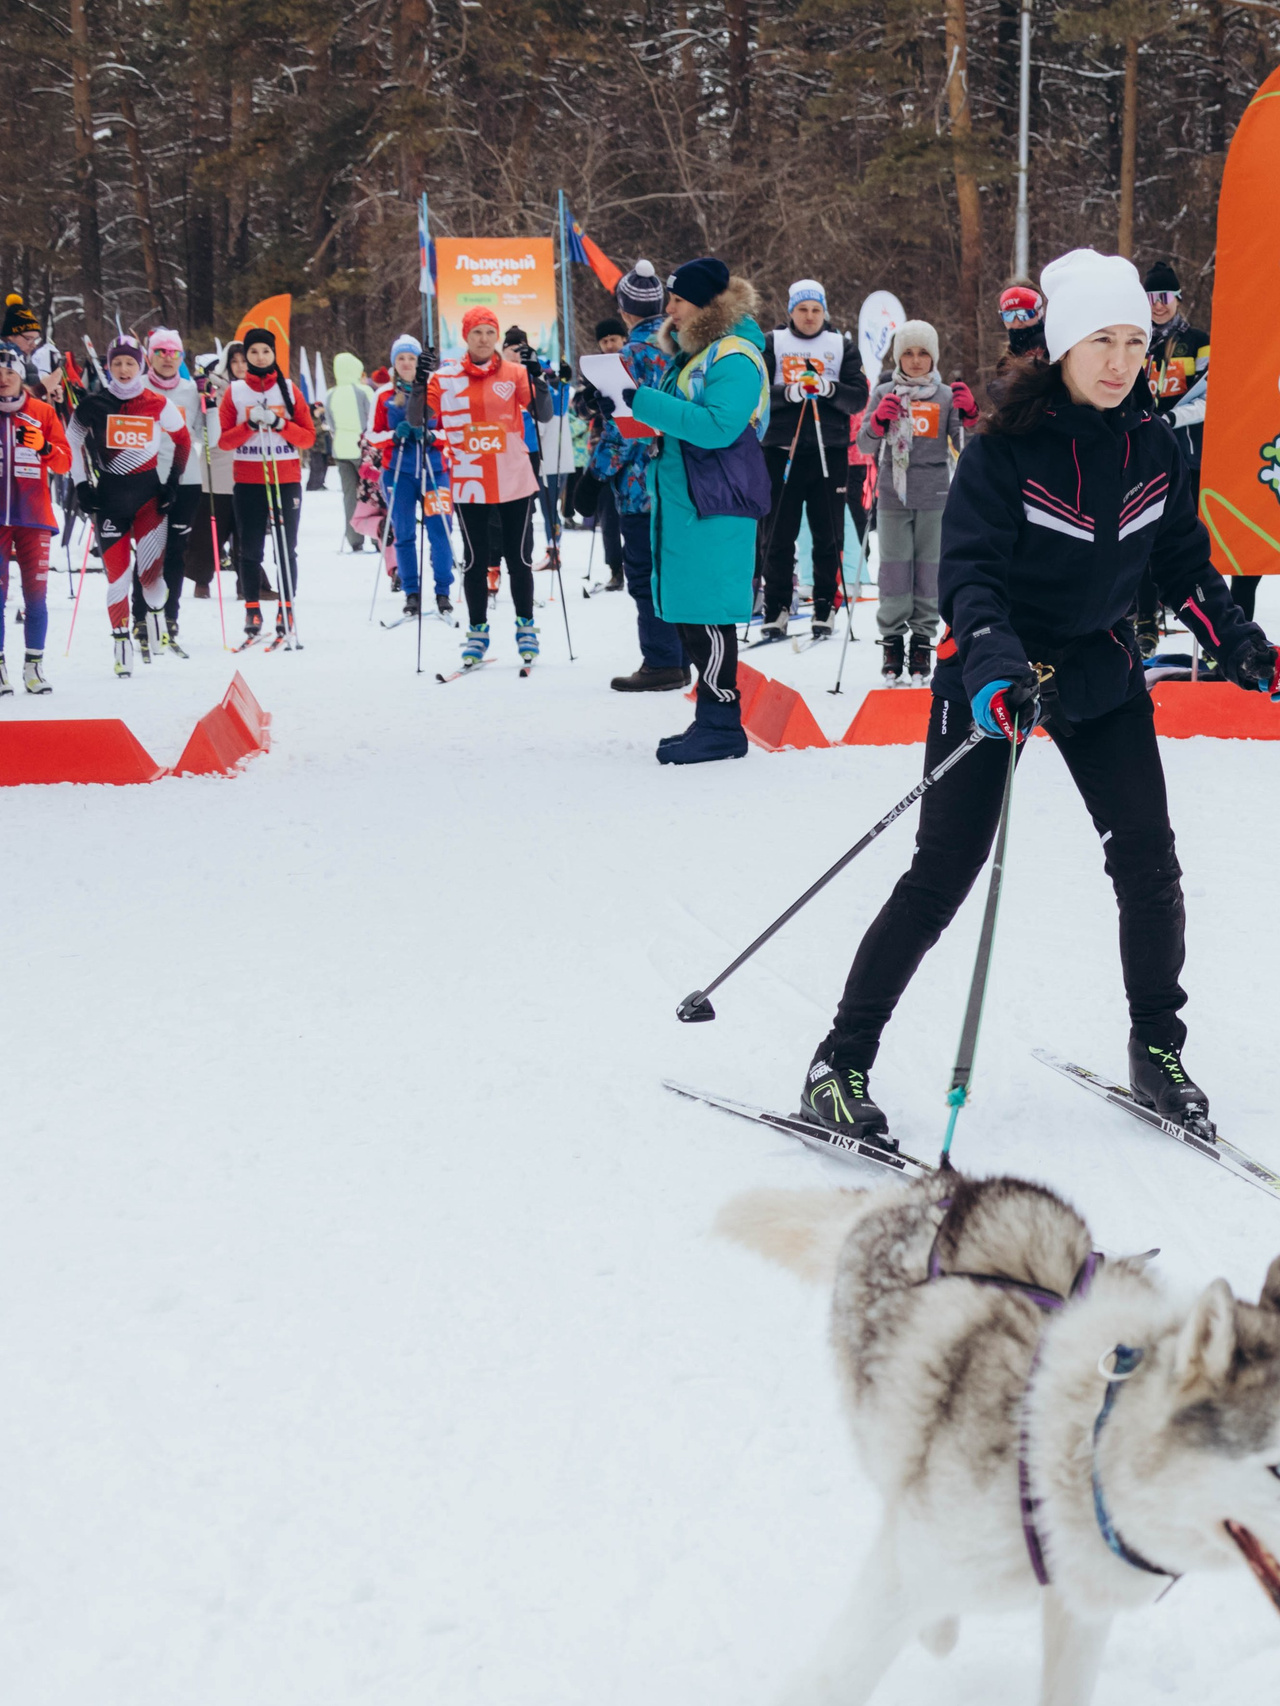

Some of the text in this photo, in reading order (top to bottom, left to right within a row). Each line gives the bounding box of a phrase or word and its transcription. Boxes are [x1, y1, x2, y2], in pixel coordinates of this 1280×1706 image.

[455, 254, 537, 271] Лыжный
[471, 269, 522, 287] забег
[113, 430, 148, 446] 085
[468, 436, 502, 452] 064
[996, 706, 1006, 721] SKI
[809, 1064, 834, 1083] TREK
[1160, 1119, 1186, 1141] TISA
[828, 1132, 860, 1154] TISA
